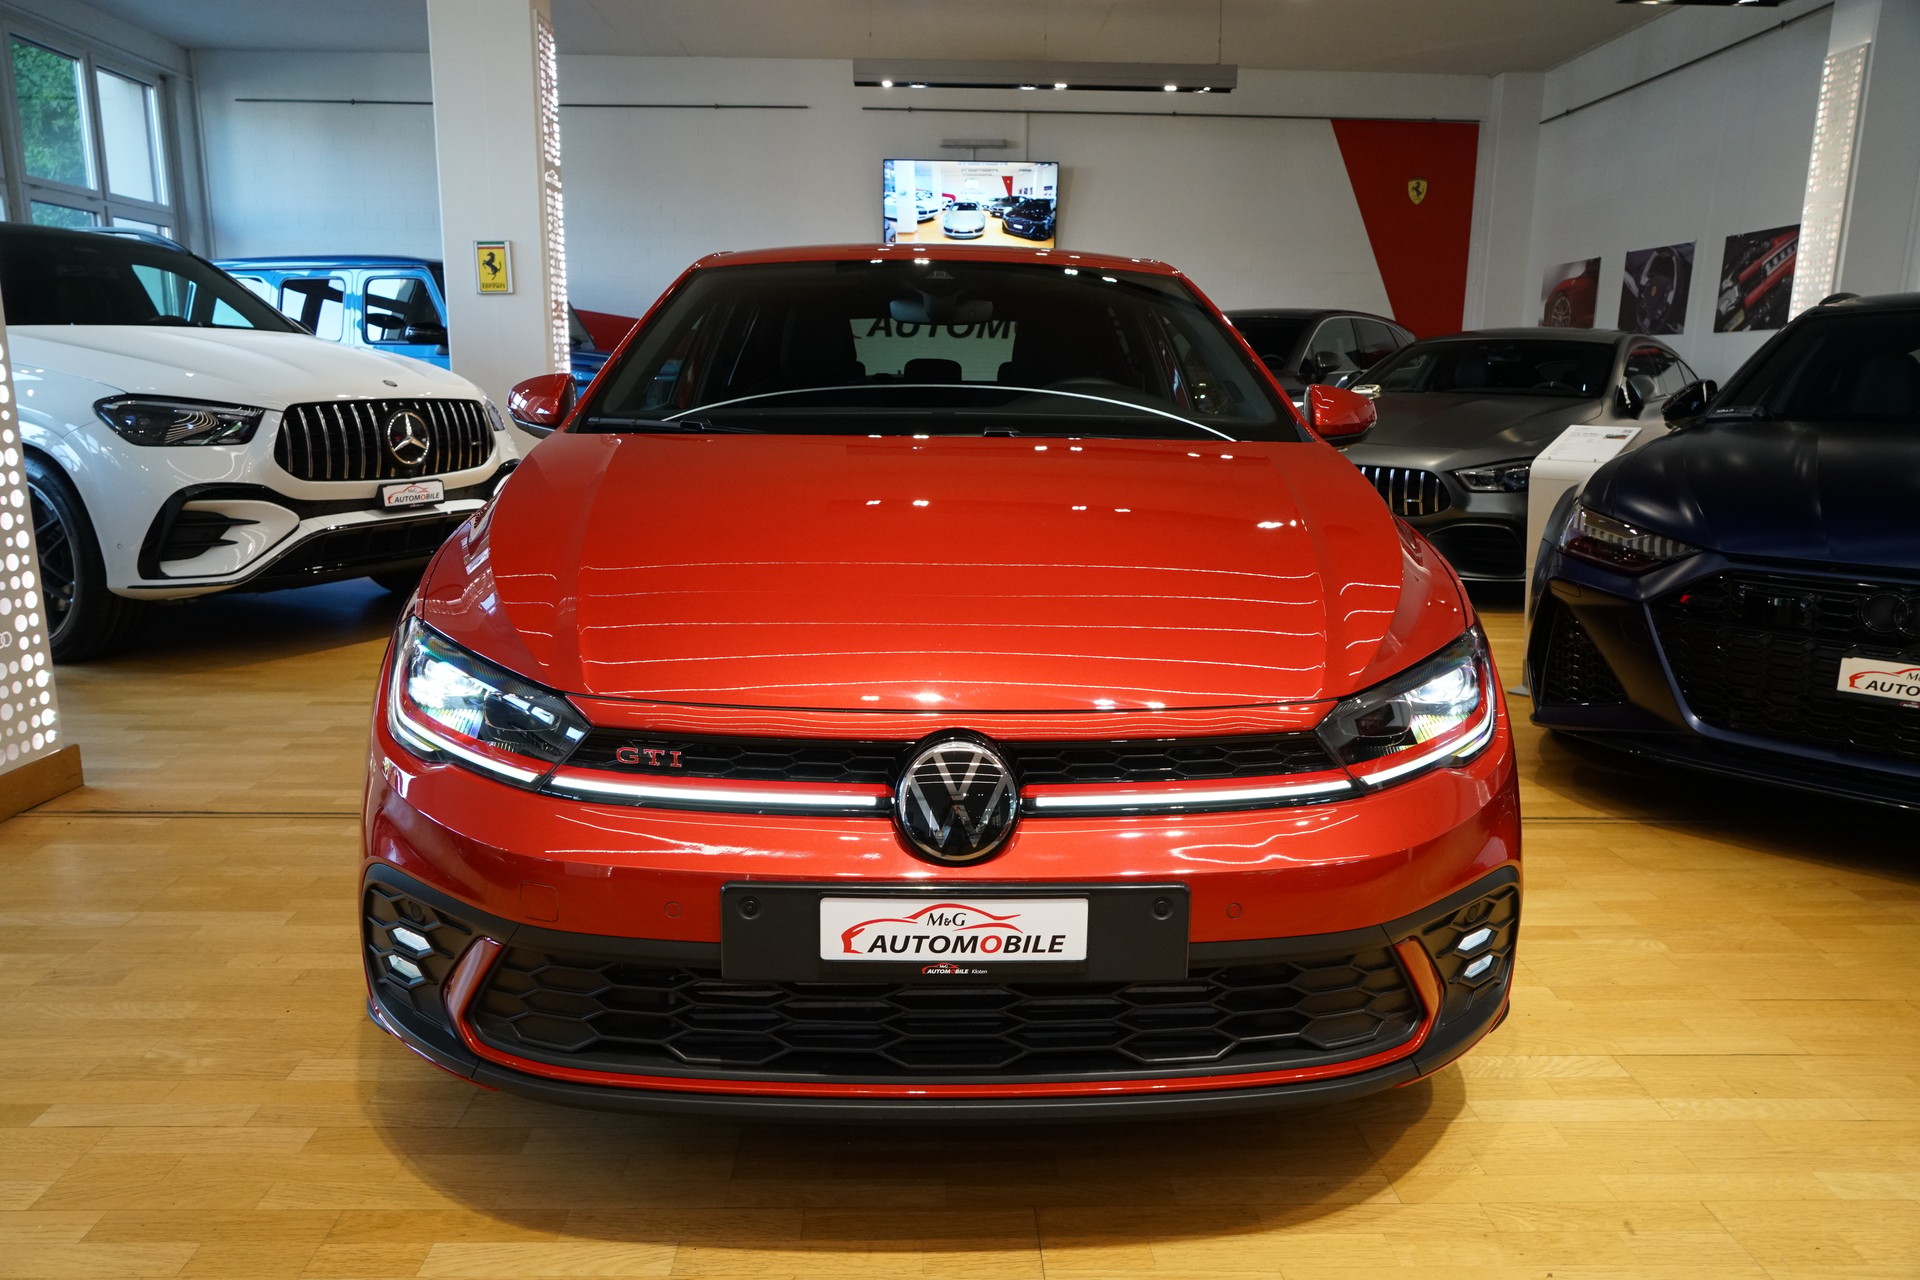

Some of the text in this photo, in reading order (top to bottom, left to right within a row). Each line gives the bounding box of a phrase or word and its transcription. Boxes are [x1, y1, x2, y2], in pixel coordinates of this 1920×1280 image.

[866, 317, 1018, 339] AUTOM
[394, 492, 440, 503] AUTOMOBILE
[1906, 672, 1920, 682] M
[615, 746, 682, 767] GTI
[926, 912, 967, 927] M&G
[867, 934, 1066, 954] AUTOMOBILE
